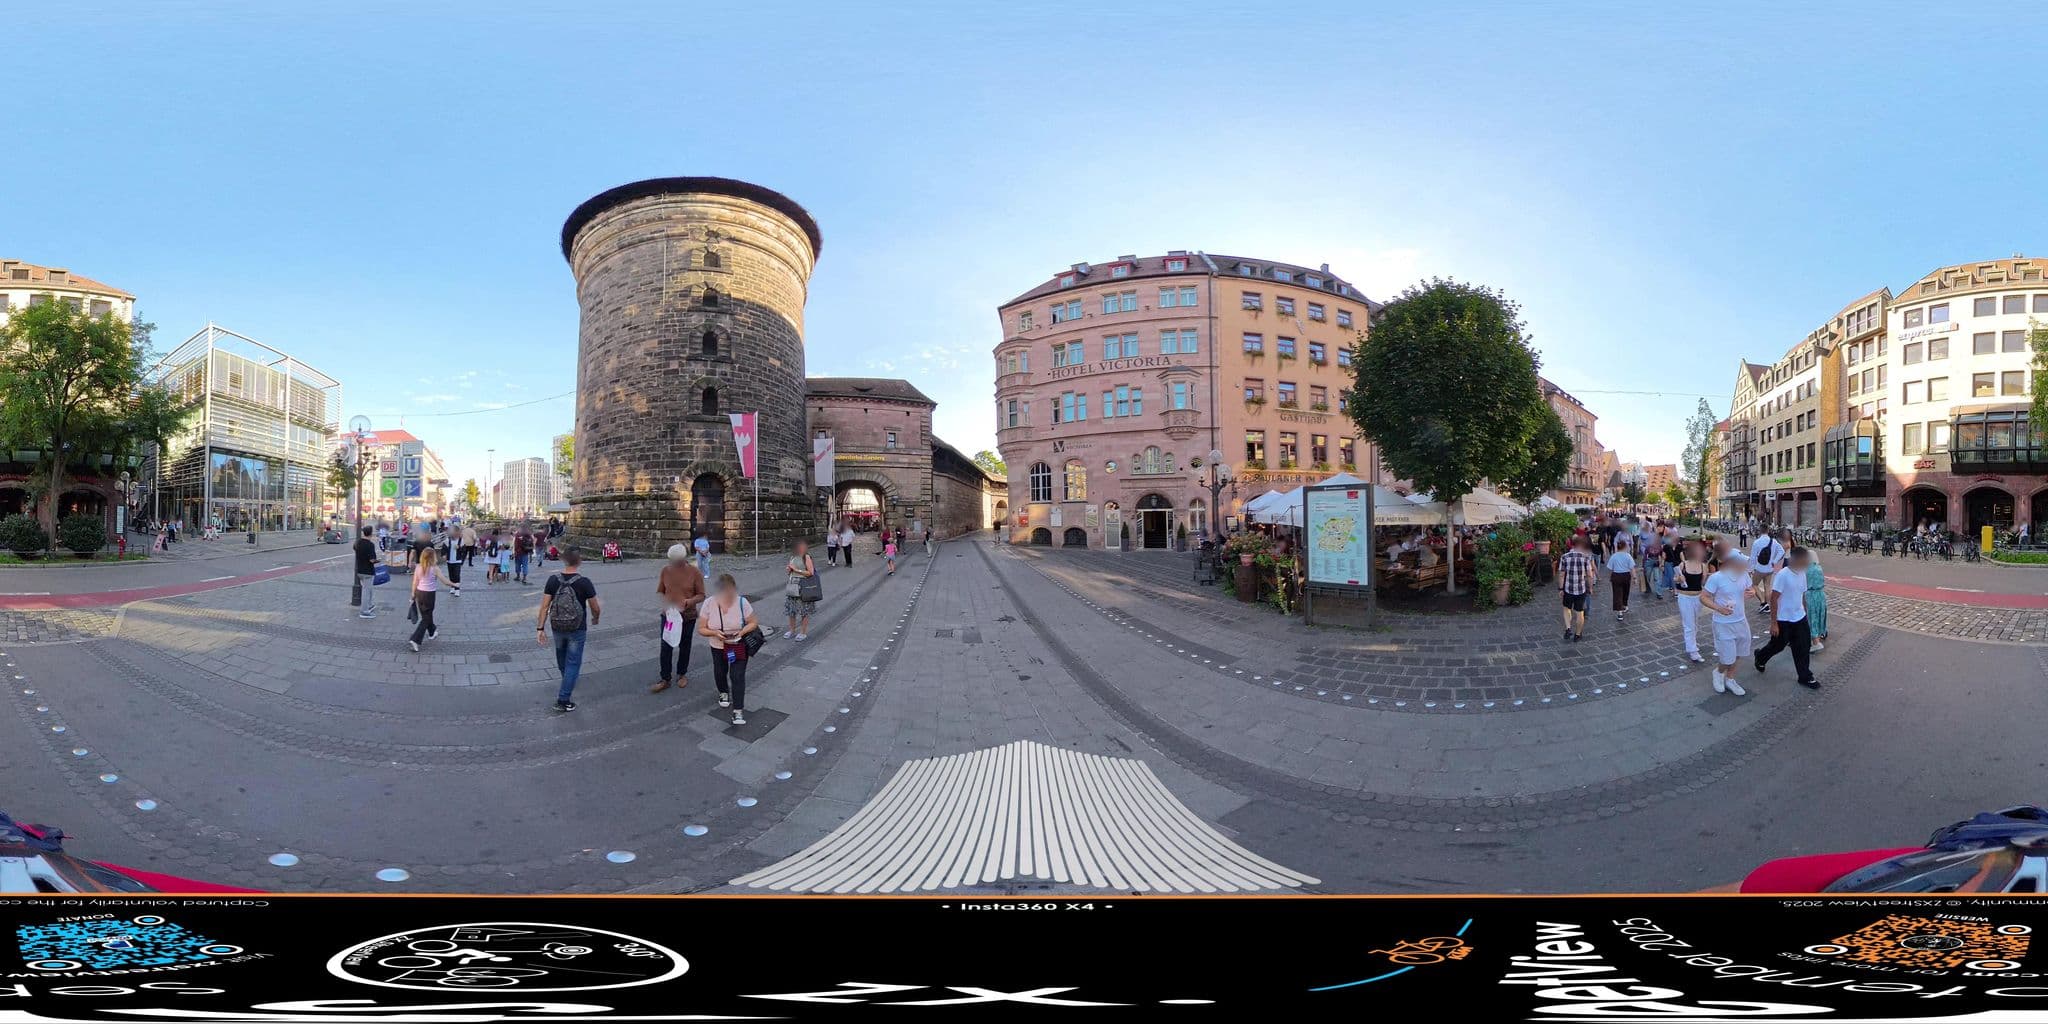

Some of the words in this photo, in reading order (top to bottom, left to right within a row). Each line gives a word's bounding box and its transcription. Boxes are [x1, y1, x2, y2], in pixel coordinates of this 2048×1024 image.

[1052, 363, 1095, 379] HOTEL
[1099, 356, 1171, 371] VICTORIA
[1280, 413, 1327, 424] GASTHAUS
[383, 462, 396, 471] DB
[406, 458, 419, 474] U
